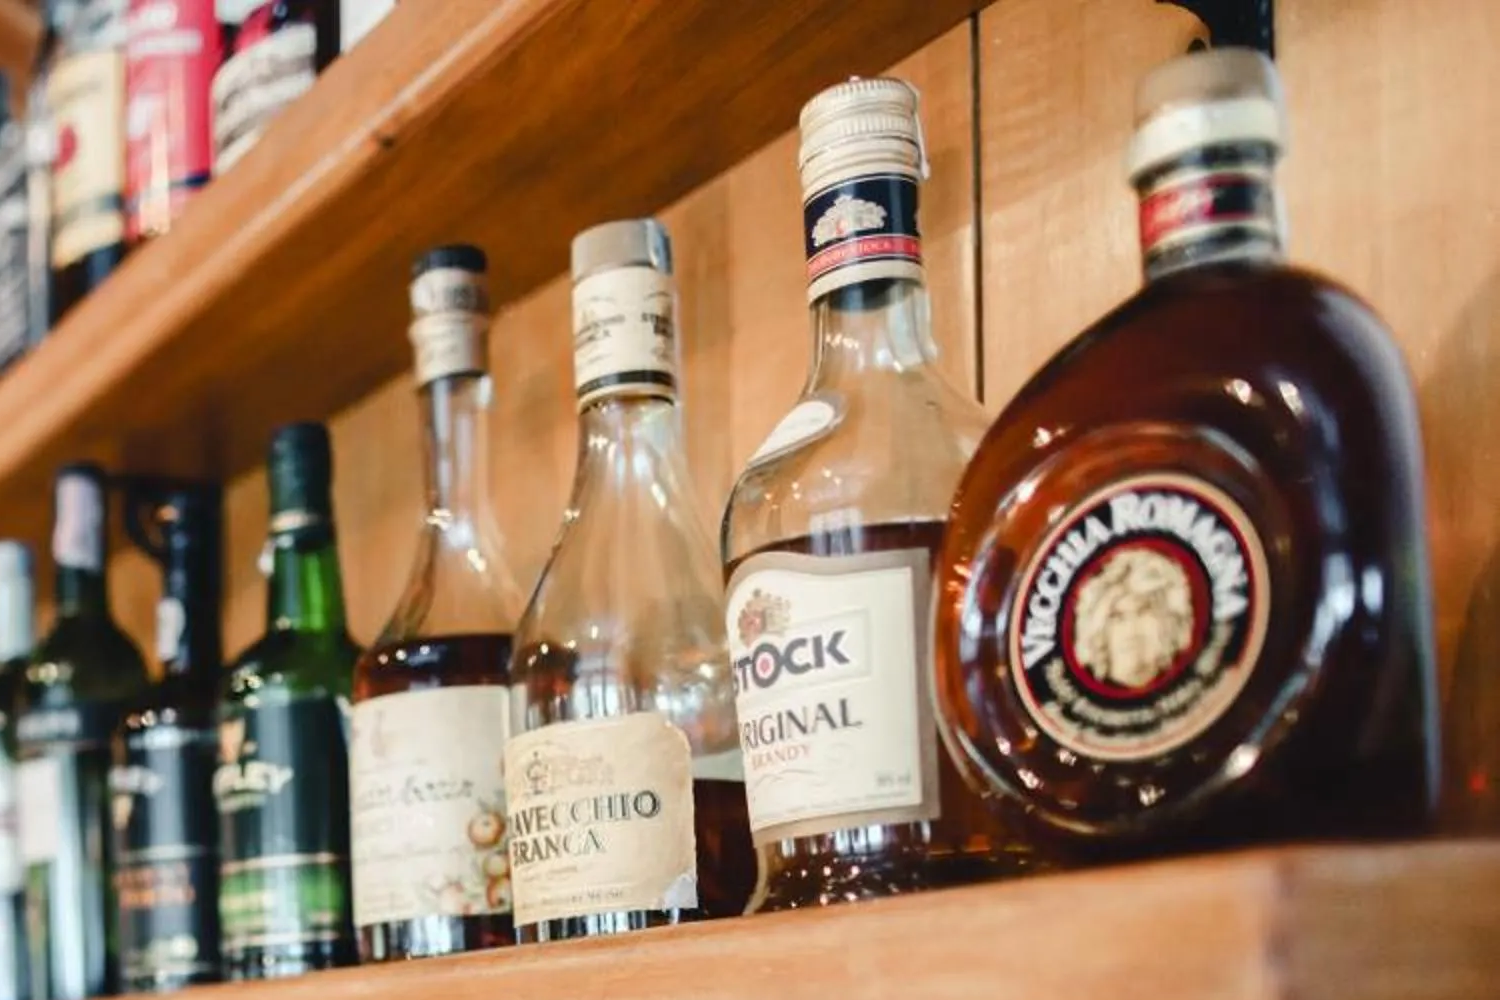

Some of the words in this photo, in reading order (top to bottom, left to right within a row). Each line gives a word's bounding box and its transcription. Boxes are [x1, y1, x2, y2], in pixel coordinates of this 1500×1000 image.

[1019, 514, 1112, 669] VECCHIA
[1109, 492, 1251, 620] ROMAGNA
[740, 698, 863, 751] RIGINAL
